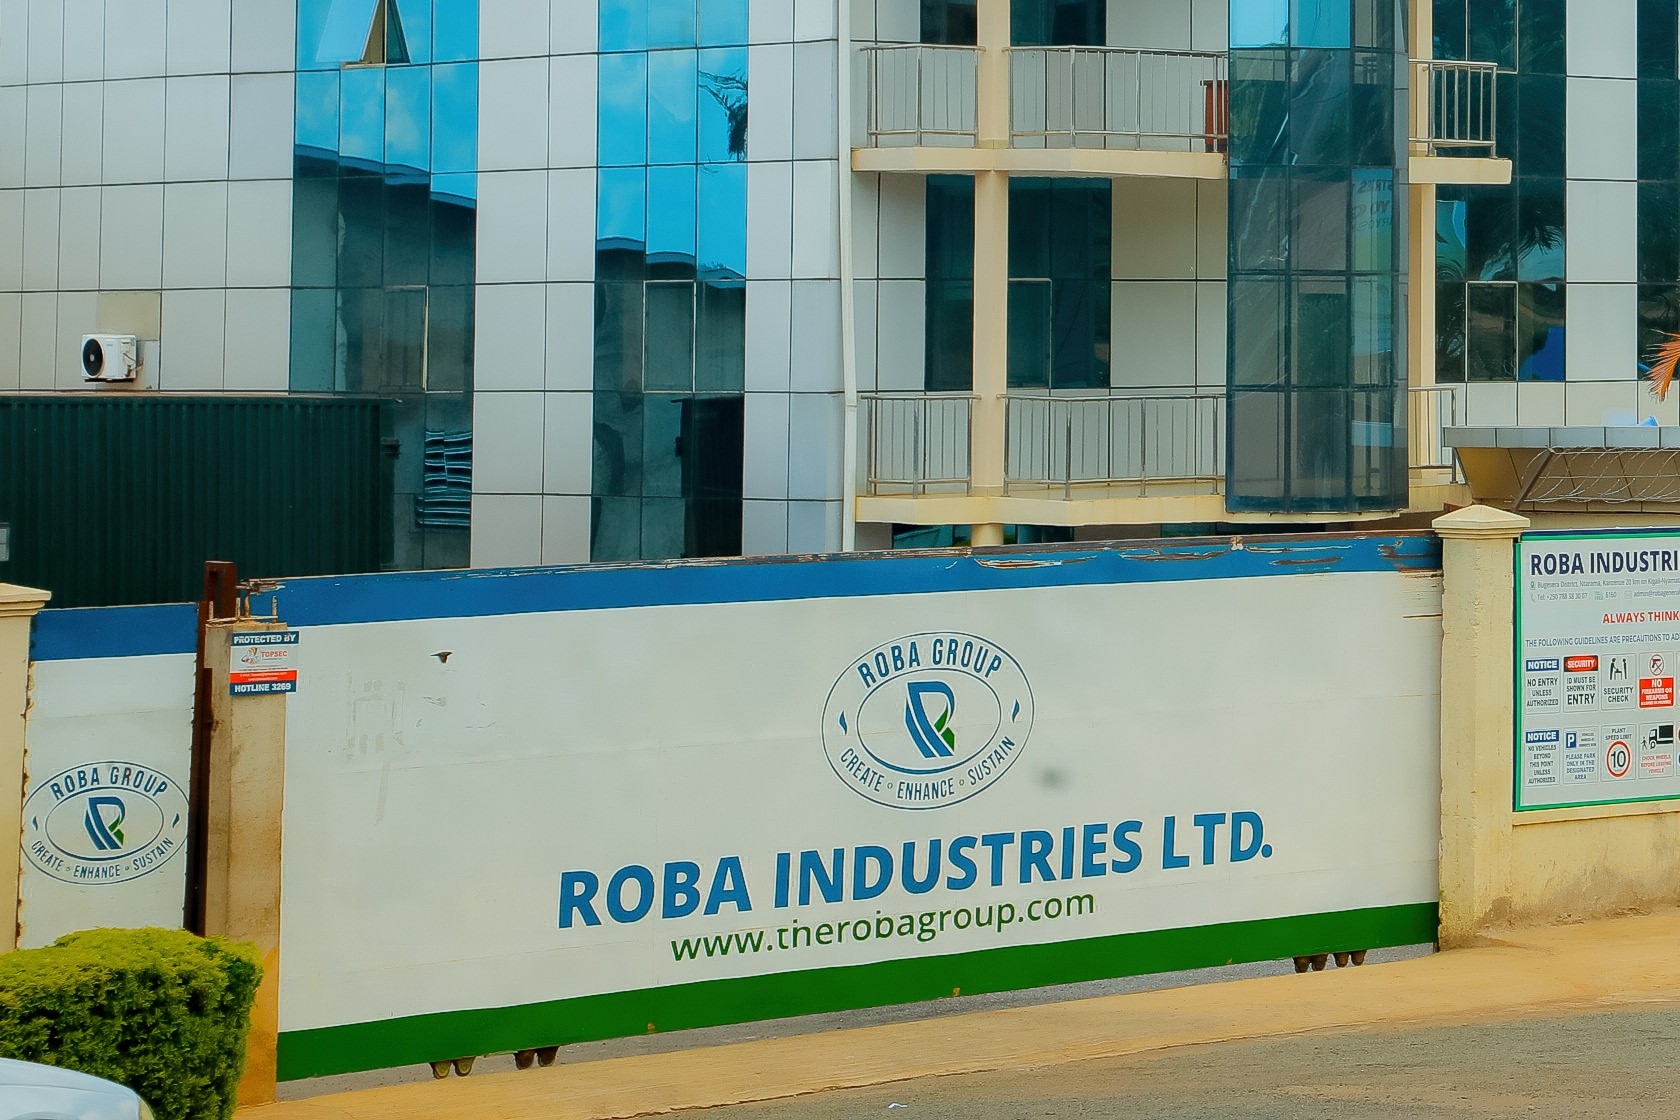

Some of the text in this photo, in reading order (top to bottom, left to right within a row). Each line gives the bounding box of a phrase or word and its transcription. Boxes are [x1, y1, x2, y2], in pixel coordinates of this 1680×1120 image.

[1530, 553, 1584, 575] ROBA
[1602, 612, 1645, 623] ALWAYS
[1647, 611, 1679, 622] THINK
[233, 633, 296, 644] PROTECTED BY
[1526, 639, 1537, 647] THE
[1538, 637, 1574, 647] FOLLOWING
[1574, 636, 1608, 646] GUIDELINES
[1608, 635, 1621, 644] ARE
[1621, 633, 1662, 643] PRECAUTIONS
[1662, 633, 1670, 641] TO
[857, 638, 1002, 688] ROBA GROUP
[1527, 660, 1558, 670] NOTICE
[1567, 659, 1595, 669] SECURITY
[1527, 677, 1558, 687] NO ENTRY
[1573, 676, 1588, 684] MUST
[1651, 679, 1662, 688] NO
[234, 682, 292, 693] HOTLINE 3269
[1603, 686, 1634, 695] SECURITY
[1567, 693, 1596, 705] ENTRY
[1608, 695, 1629, 703] CHECK
[1527, 732, 1557, 741] NOTICE
[1567, 734, 1575, 746] P
[1610, 750, 1626, 768] 10
[840, 736, 1016, 801] CREATE ENHANCE SUSTAIN
[50, 766, 168, 801] ROBA GROUP
[31, 837, 174, 879] CREATE ENHANCE SUSTAIN
[558, 810, 1274, 929] ROBA INDUSTRIES LTD.
[670, 892, 1095, 961] www.therobagroup.com
